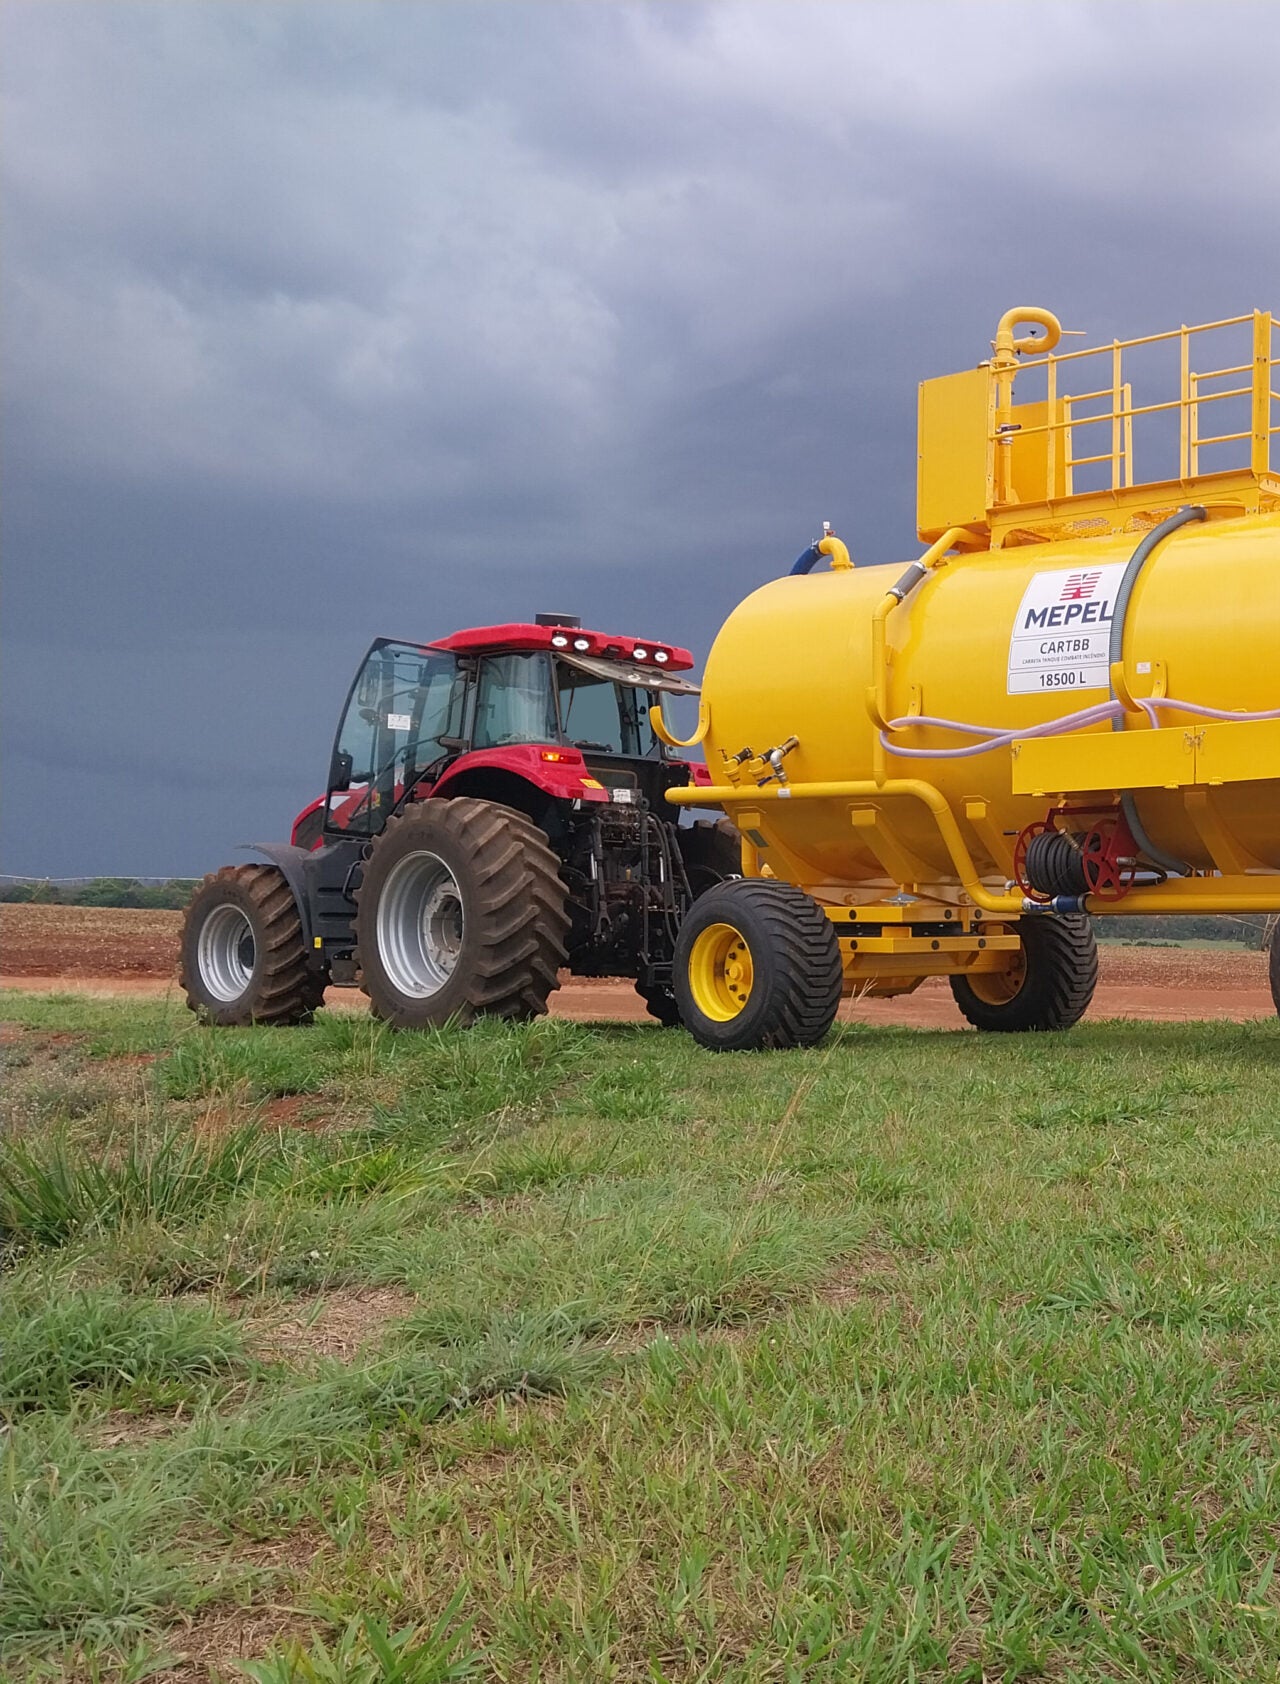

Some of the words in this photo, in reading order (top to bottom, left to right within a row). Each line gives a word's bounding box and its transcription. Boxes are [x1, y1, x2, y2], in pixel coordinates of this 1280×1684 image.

[1024, 600, 1113, 629] MEPEL
[1040, 638, 1090, 655] CARTBB
[1040, 671, 1076, 687] 18500
[1079, 671, 1086, 684] L
